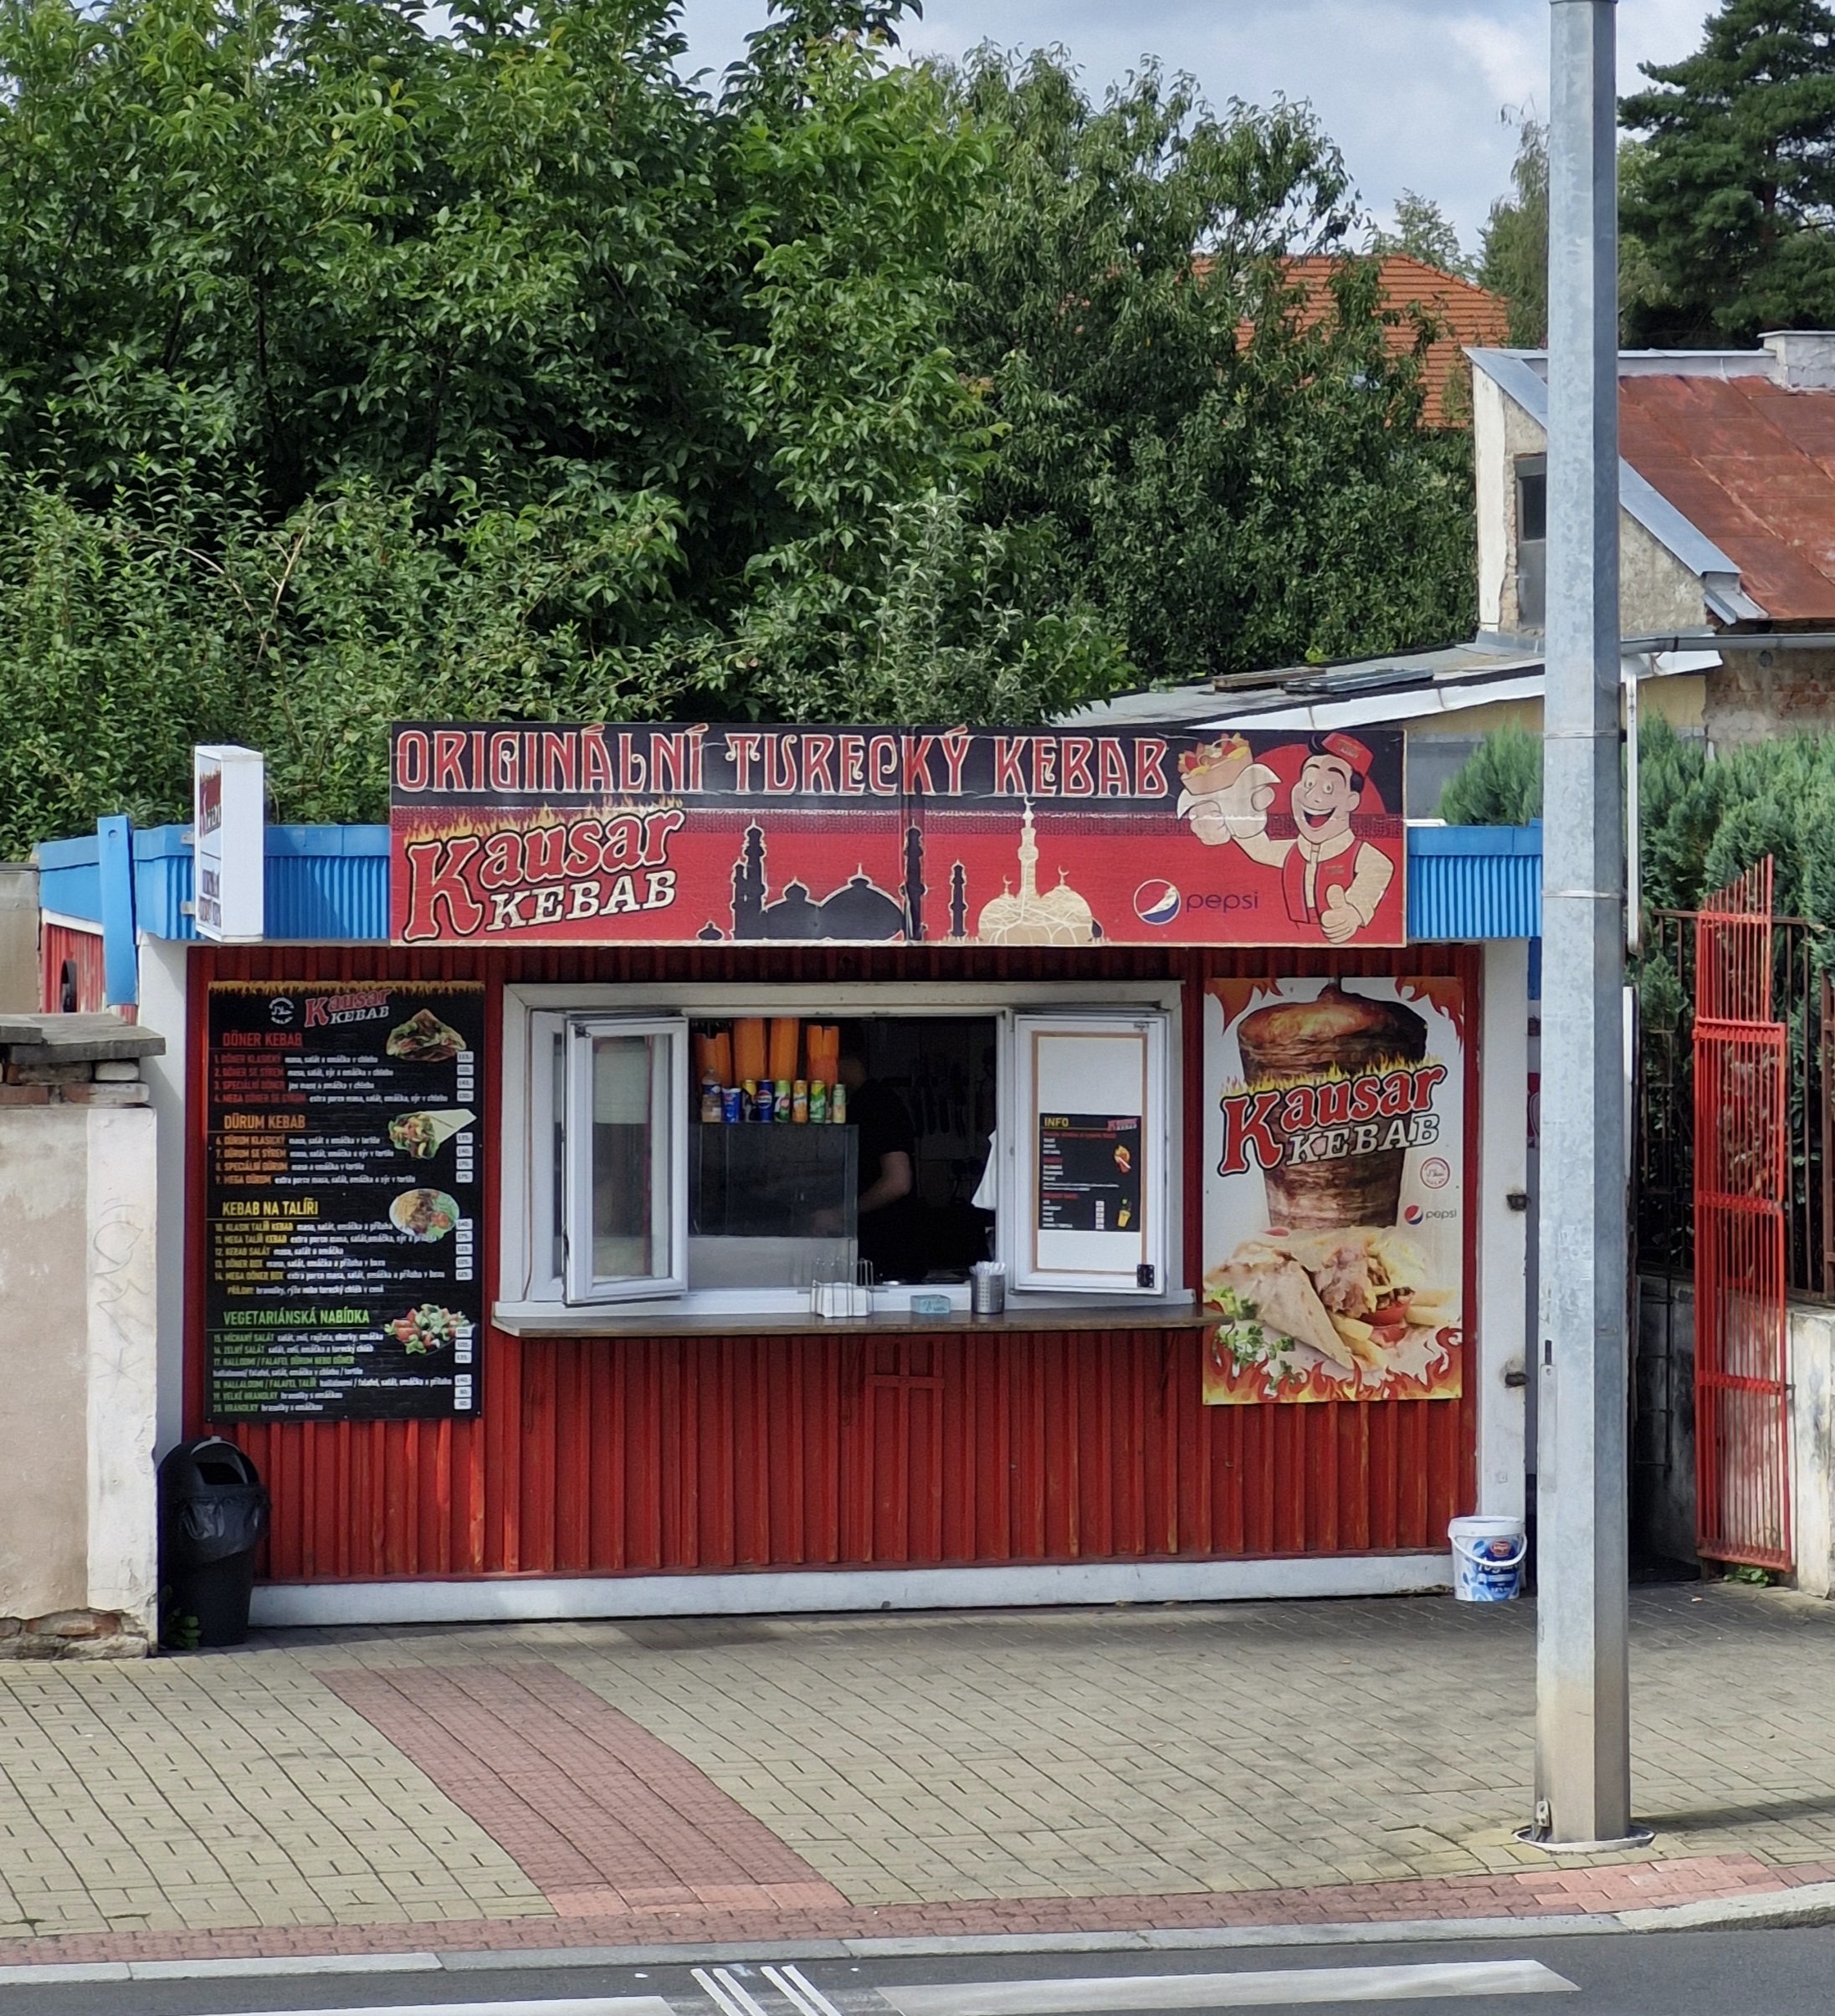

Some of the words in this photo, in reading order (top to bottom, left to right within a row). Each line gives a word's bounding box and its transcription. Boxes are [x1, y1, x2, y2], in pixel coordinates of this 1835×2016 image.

[396, 723, 709, 795] ORIGINÁLNÍ
[725, 725, 975, 797] TURECKÝ
[993, 734, 1169, 798] KEBAB
[403, 808, 684, 942] Kausar
[485, 869, 677, 931] KEBAB
[1185, 888, 1258, 915] pepsi
[304, 990, 392, 1029] Kausar
[330, 1006, 390, 1024] KEBAB
[223, 1029, 261, 1047] DÖNER
[265, 1032, 303, 1046] KEBAB
[224, 1112, 264, 1129] DÜRUM
[268, 1115, 305, 1129] KEBAB
[1043, 1116, 1069, 1127] INFO
[1217, 1064, 1448, 1177] Kausar
[1286, 1114, 1440, 1166] KEBAB
[222, 1201, 260, 1216] KEBAB
[263, 1201, 279, 1215] NA
[282, 1197, 319, 1215] TALÍŘI
[1425, 1208, 1458, 1221] pepsi
[223, 1306, 317, 1325] VEGETARIÁNSKÁ
[320, 1306, 370, 1324] NABÍDKA
